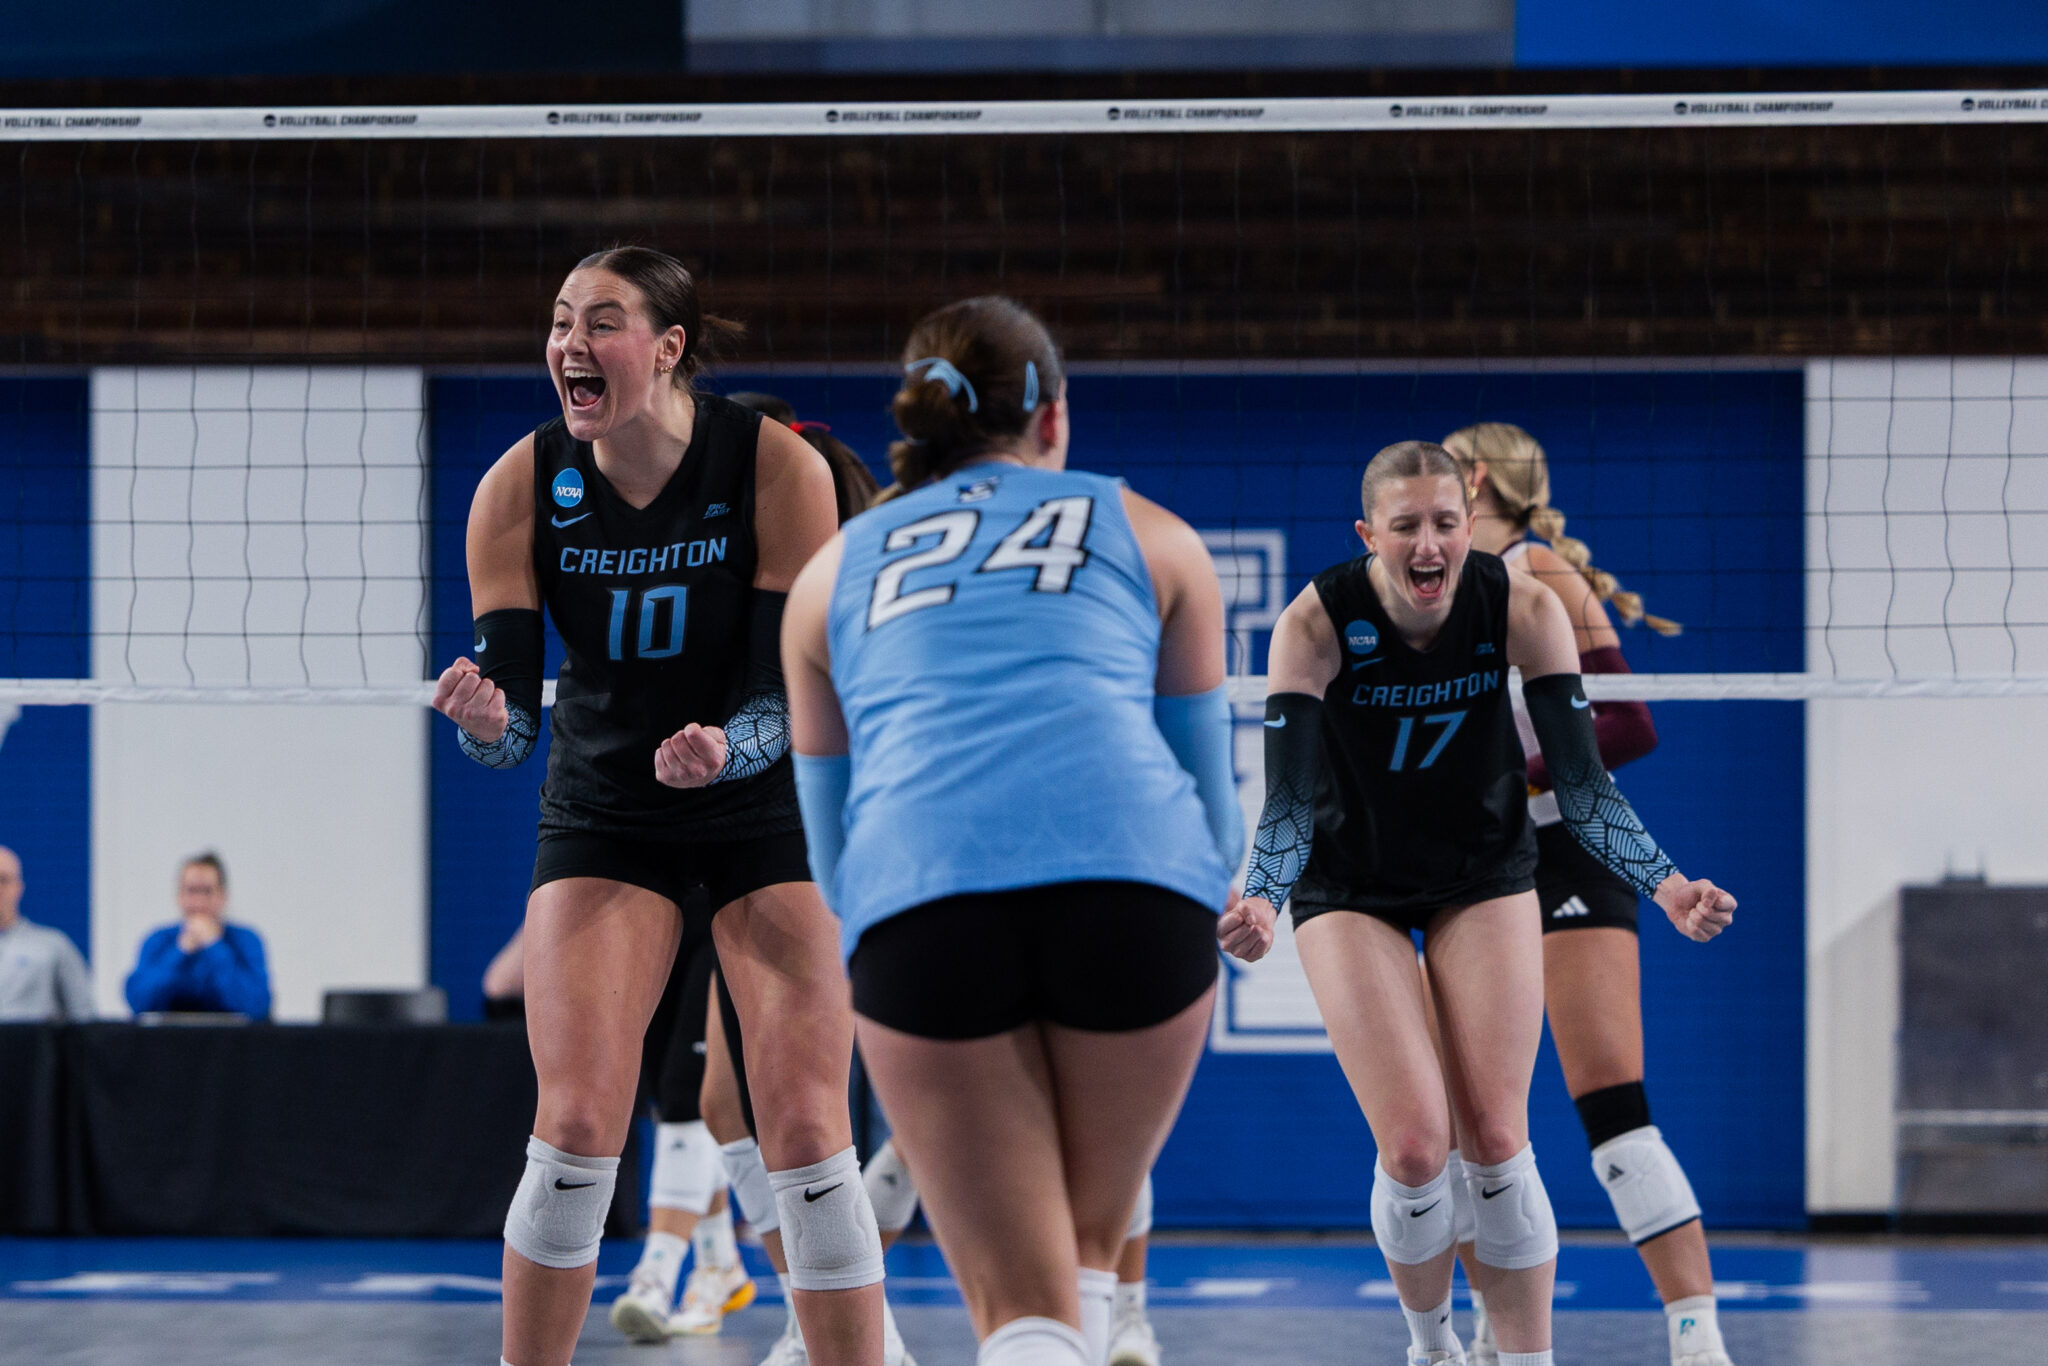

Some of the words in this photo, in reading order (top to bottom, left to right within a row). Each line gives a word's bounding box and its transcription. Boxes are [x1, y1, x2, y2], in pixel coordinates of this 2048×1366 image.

[1406, 106, 1465, 117] VOLLEYBALL
[1468, 104, 1548, 116] CHAMPIONSHIP
[1691, 103, 1750, 114] VOLLEYBALL
[1753, 101, 1834, 114] CHAMPIONSHIP
[1978, 98, 2037, 110] VOLLEYBALL
[563, 113, 621, 124] VOLLEYBALL
[624, 112, 703, 123] CHAMPIONSHIP
[842, 111, 900, 122] VOLLEYBALL
[904, 110, 982, 121] CHAMPIONSHIP
[1123, 108, 1182, 119] VOLLEYBALL
[1185, 107, 1265, 119] CHAMPIONSHIP
[4, 117, 62, 128] VOLLEYBALL
[65, 117, 142, 128] CHAMPIONSHIP
[280, 115, 337, 127] VOLLEYBALL
[341, 115, 418, 126] CHAMPIONSHIP
[555, 486, 583, 499] NCAA
[559, 536, 728, 575] CREIGHTON
[865, 495, 1095, 632] 24
[606, 583, 691, 662] 10
[1348, 635, 1377, 646] NCAA
[1352, 669, 1500, 708] CREIGHTON
[1388, 709, 1469, 773] 17
